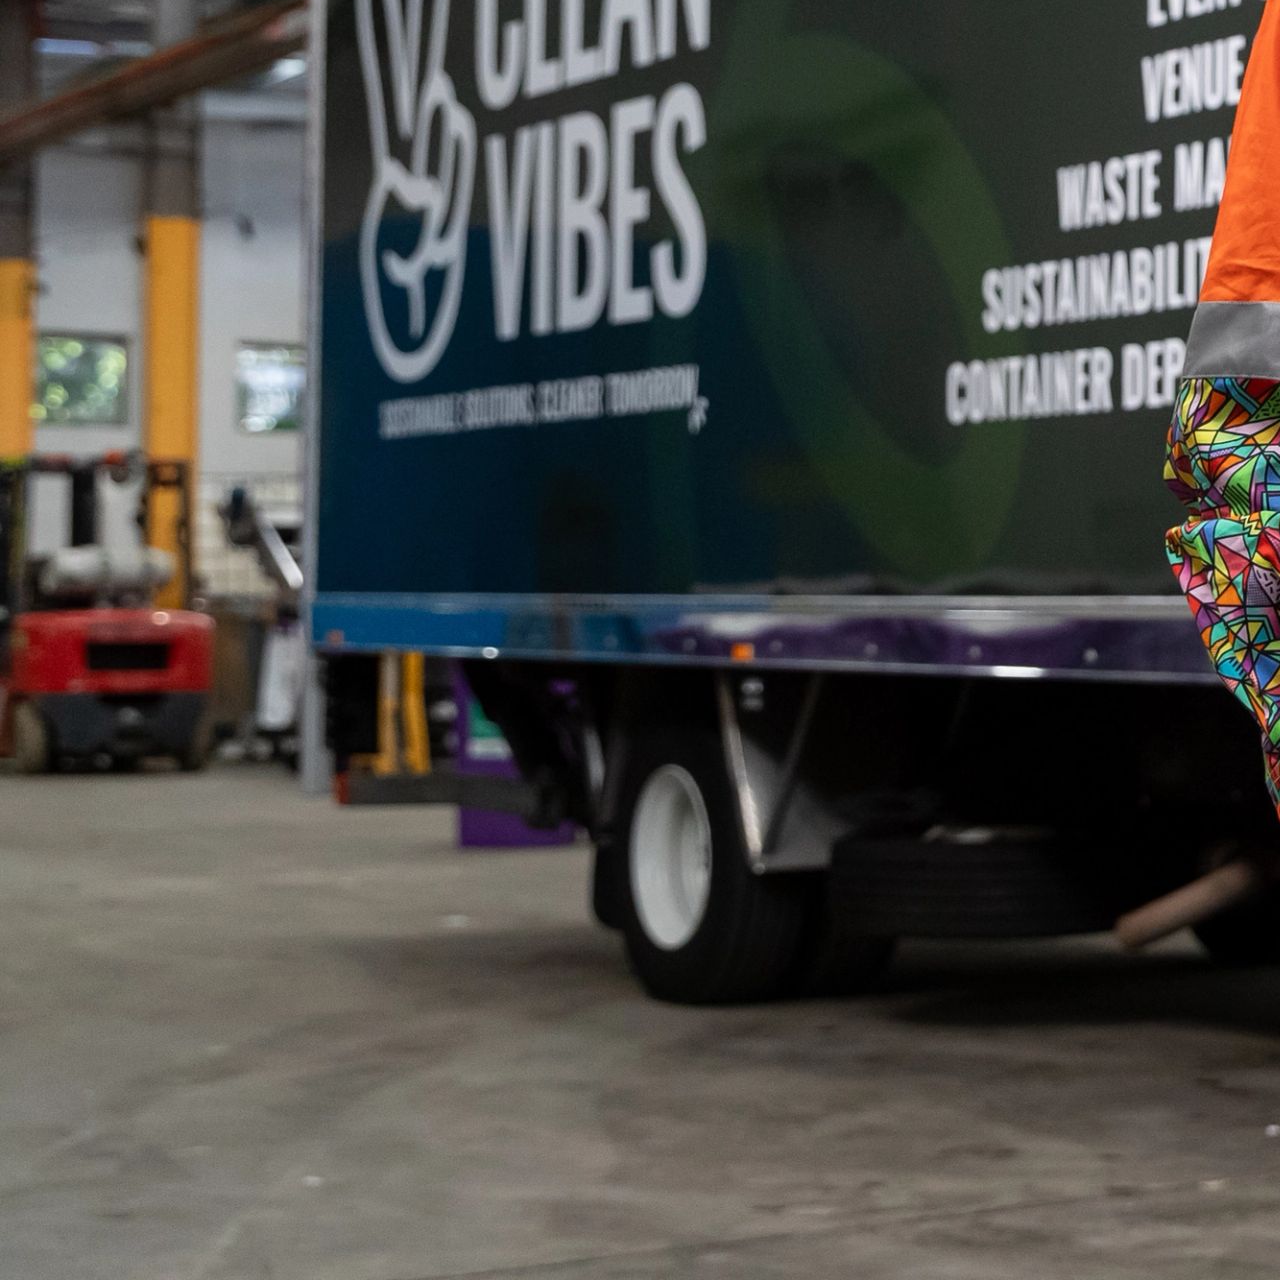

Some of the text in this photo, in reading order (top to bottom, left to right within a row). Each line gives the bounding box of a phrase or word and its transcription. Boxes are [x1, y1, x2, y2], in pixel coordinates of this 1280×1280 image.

[1140, 35, 1246, 124] VENUE
[484, 82, 707, 341] VIBES
[1057, 134, 1232, 232] WASTE MA
[945, 347, 1113, 424] CONTAINER
